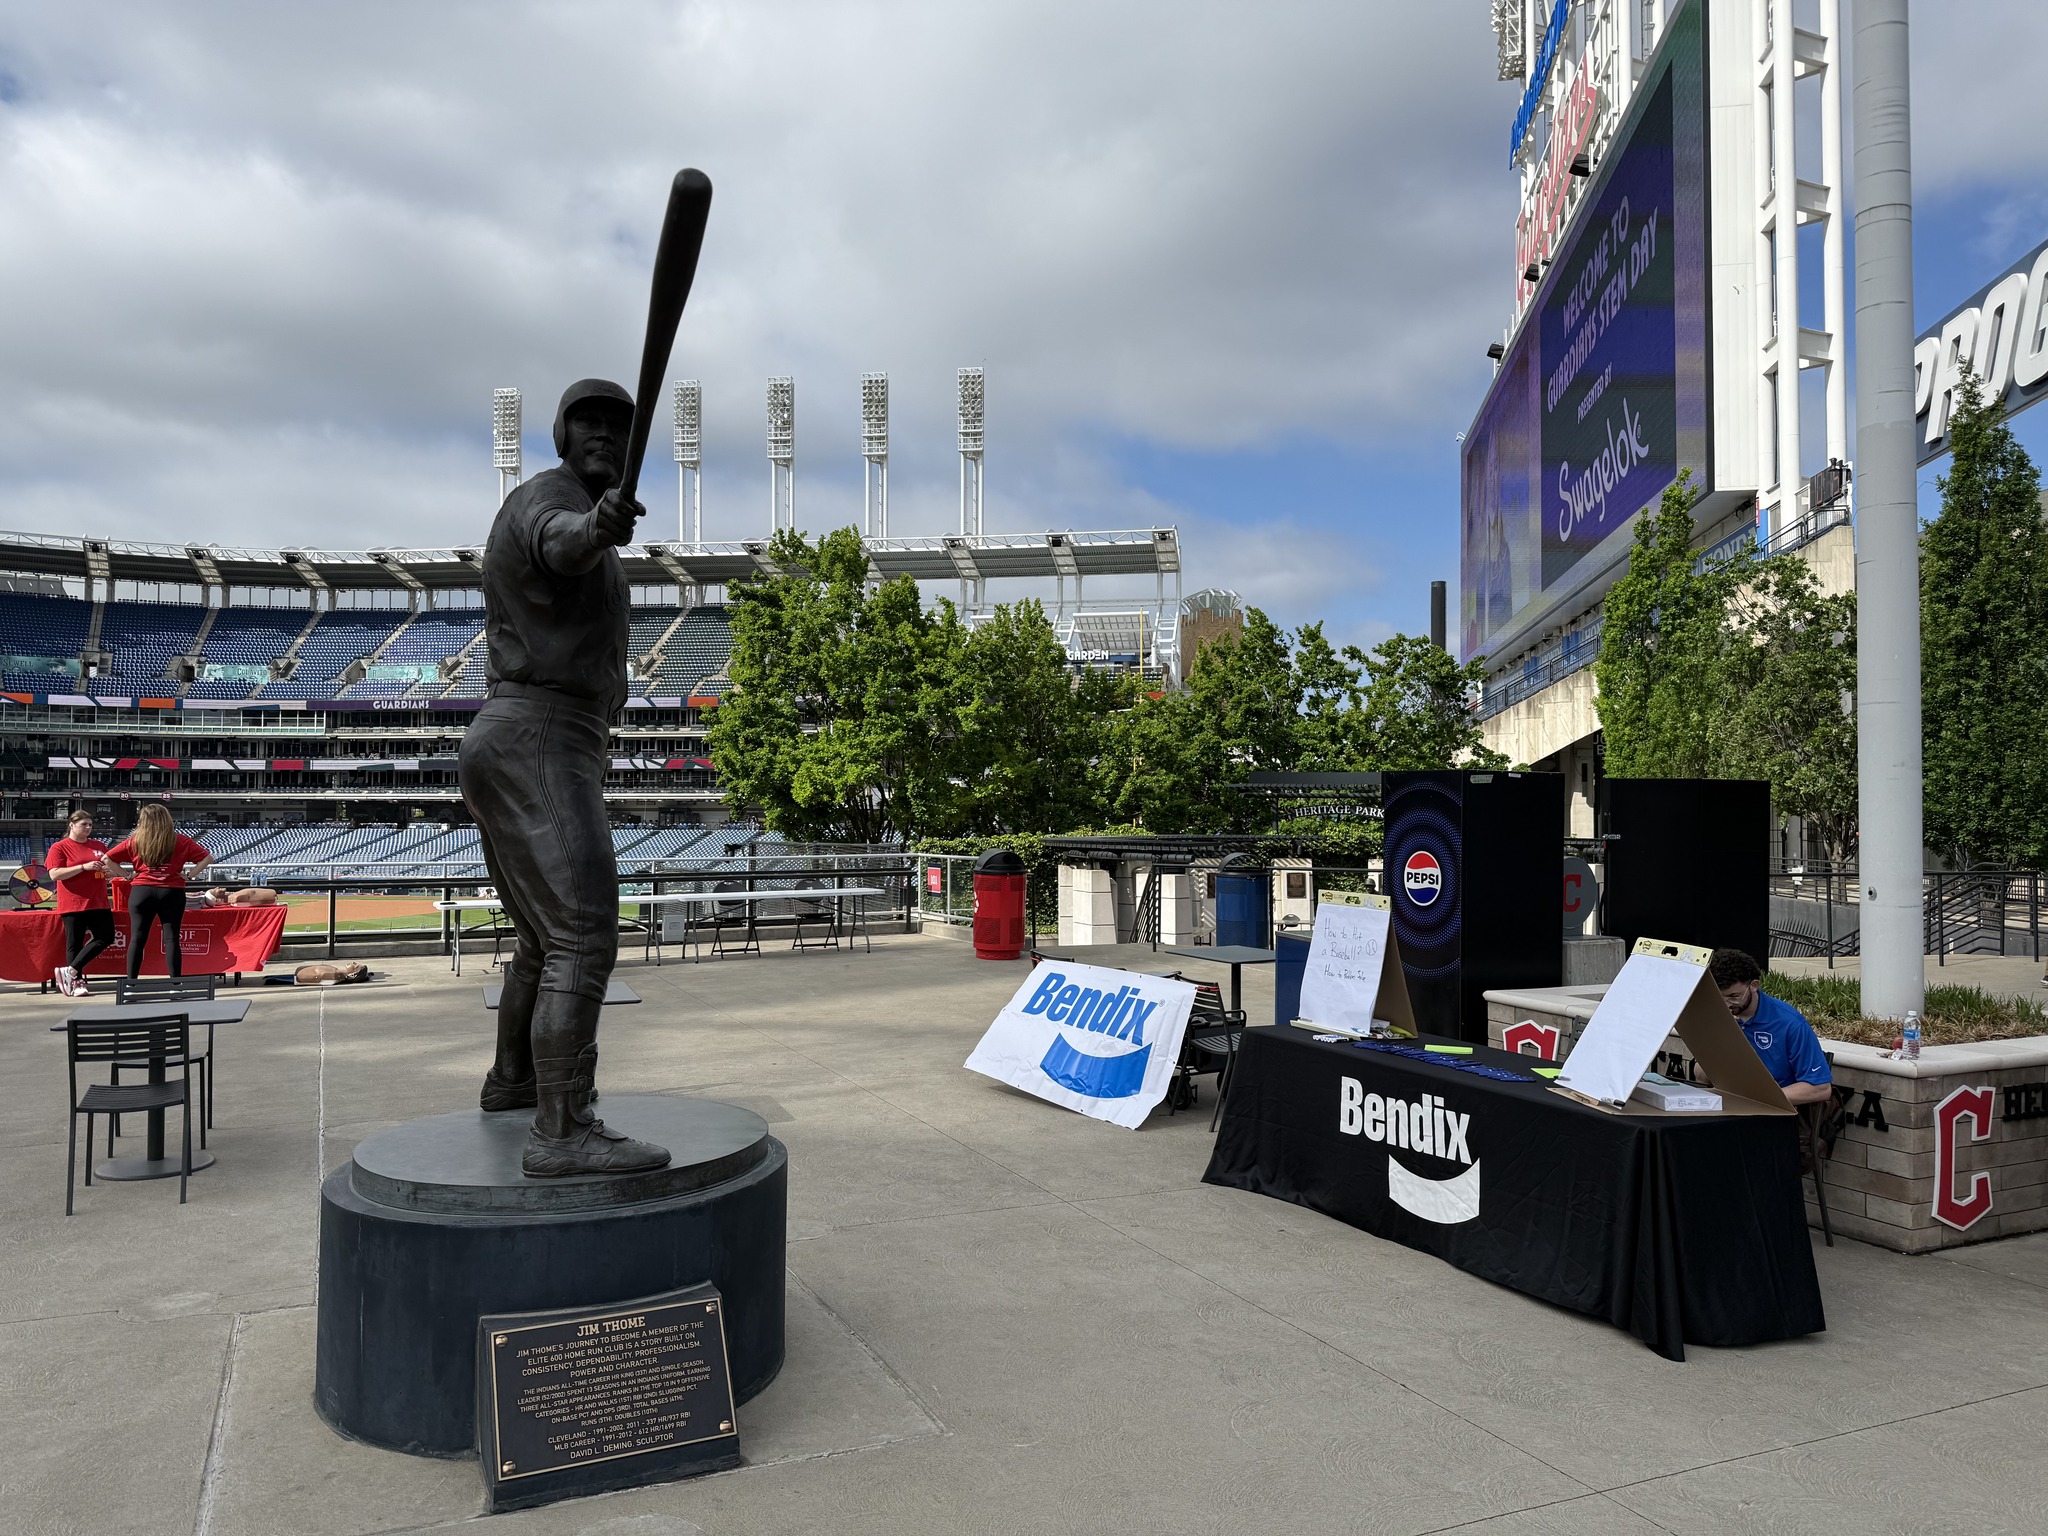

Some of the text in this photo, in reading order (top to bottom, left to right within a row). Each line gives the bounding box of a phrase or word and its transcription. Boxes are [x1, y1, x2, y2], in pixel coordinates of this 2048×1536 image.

[1563, 195, 1629, 339] WELCOME TO
[1547, 206, 1658, 413] GUARDIANS STEM DAY
[1577, 362, 1612, 424] PRESENTED BY
[1559, 397, 1649, 542] Swagelok
[1066, 649, 1109, 660] GARDEN
[372, 700, 430, 709] GUARDIANS
[1294, 804, 1384, 818] HERITAGE PARK
[1406, 871, 1439, 885] PEPSI
[1324, 917, 1337, 939] How
[1341, 926, 1348, 939] to
[1022, 972, 1158, 1047] Bendix
[1339, 1075, 1473, 1166] Bendix
[1931, 1084, 1996, 1232] C
[515, 1348, 529, 1357] JIM
[530, 1343, 563, 1355] THOME'S
[565, 1337, 598, 1350] JOURNEY
[610, 1331, 640, 1342] BECOME
[648, 1325, 678, 1336] MEMBER
[690, 1321, 703, 1329] THE
[576, 1316, 645, 1337] JIM THOME
[527, 1355, 548, 1365] ELITE
[549, 1353, 562, 1361] 600
[564, 1349, 585, 1359] HOME
[587, 1346, 602, 1355] RUN
[604, 1343, 623, 1353] CLUB
[640, 1336, 662, 1347] STORY
[664, 1333, 683, 1343] BUILT
[517, 1395, 540, 1405] LEADER
[566, 1387, 585, 1396] SPENT
[593, 1381, 620, 1391] SEASONS
[636, 1374, 659, 1384] INDIANS
[686, 1365, 710, 1375] EARNING
[523, 1387, 534, 1395] THE
[536, 1383, 560, 1393] INDIANS
[560, 1378, 587, 1389] ALL-TIME
[588, 1375, 610, 1384] CAREER
[620, 1371, 634, 1379] KING
[648, 1366, 660, 1374] AND
[660, 1359, 703, 1372] SINGLE-SEASON
[570, 1367, 596, 1378] POWER
[597, 1364, 614, 1373] AND
[520, 1403, 538, 1412] THREE
[539, 1398, 567, 1409] ALL-STAR
[612, 1387, 632, 1396] RANKS
[651, 1381, 662, 1389] TOP
[680, 1373, 709, 1384] OFFENSIVE
[535, 1406, 569, 1418] CATEGORIES
[583, 1401, 596, 1409] AND
[597, 1398, 617, 1407] WALKS
[658, 1385, 686, 1396] SLUGGING
[551, 1413, 577, 1424] ON-BASE
[578, 1411, 589, 1419] PCT
[590, 1408, 603, 1417] AND
[632, 1400, 649, 1409] TOTAL
[650, 1397, 668, 1406] BASES
[581, 1418, 597, 1427] RUNS
[614, 1410, 640, 1420] DOUBLES
[547, 1430, 586, 1444] CLEVELAND
[626, 1420, 639, 1429] 2011
[645, 1417, 656, 1425] 337
[657, 1413, 679, 1423] HR/937
[554, 1442, 568, 1451] MLB
[569, 1437, 595, 1448] CAREER
[602, 1430, 632, 1442] 1991-2012
[638, 1427, 648, 1435] 612
[649, 1422, 674, 1433] HR/1699
[570, 1447, 592, 1459] DAVID
[635, 1431, 673, 1447] SCULPTOR
